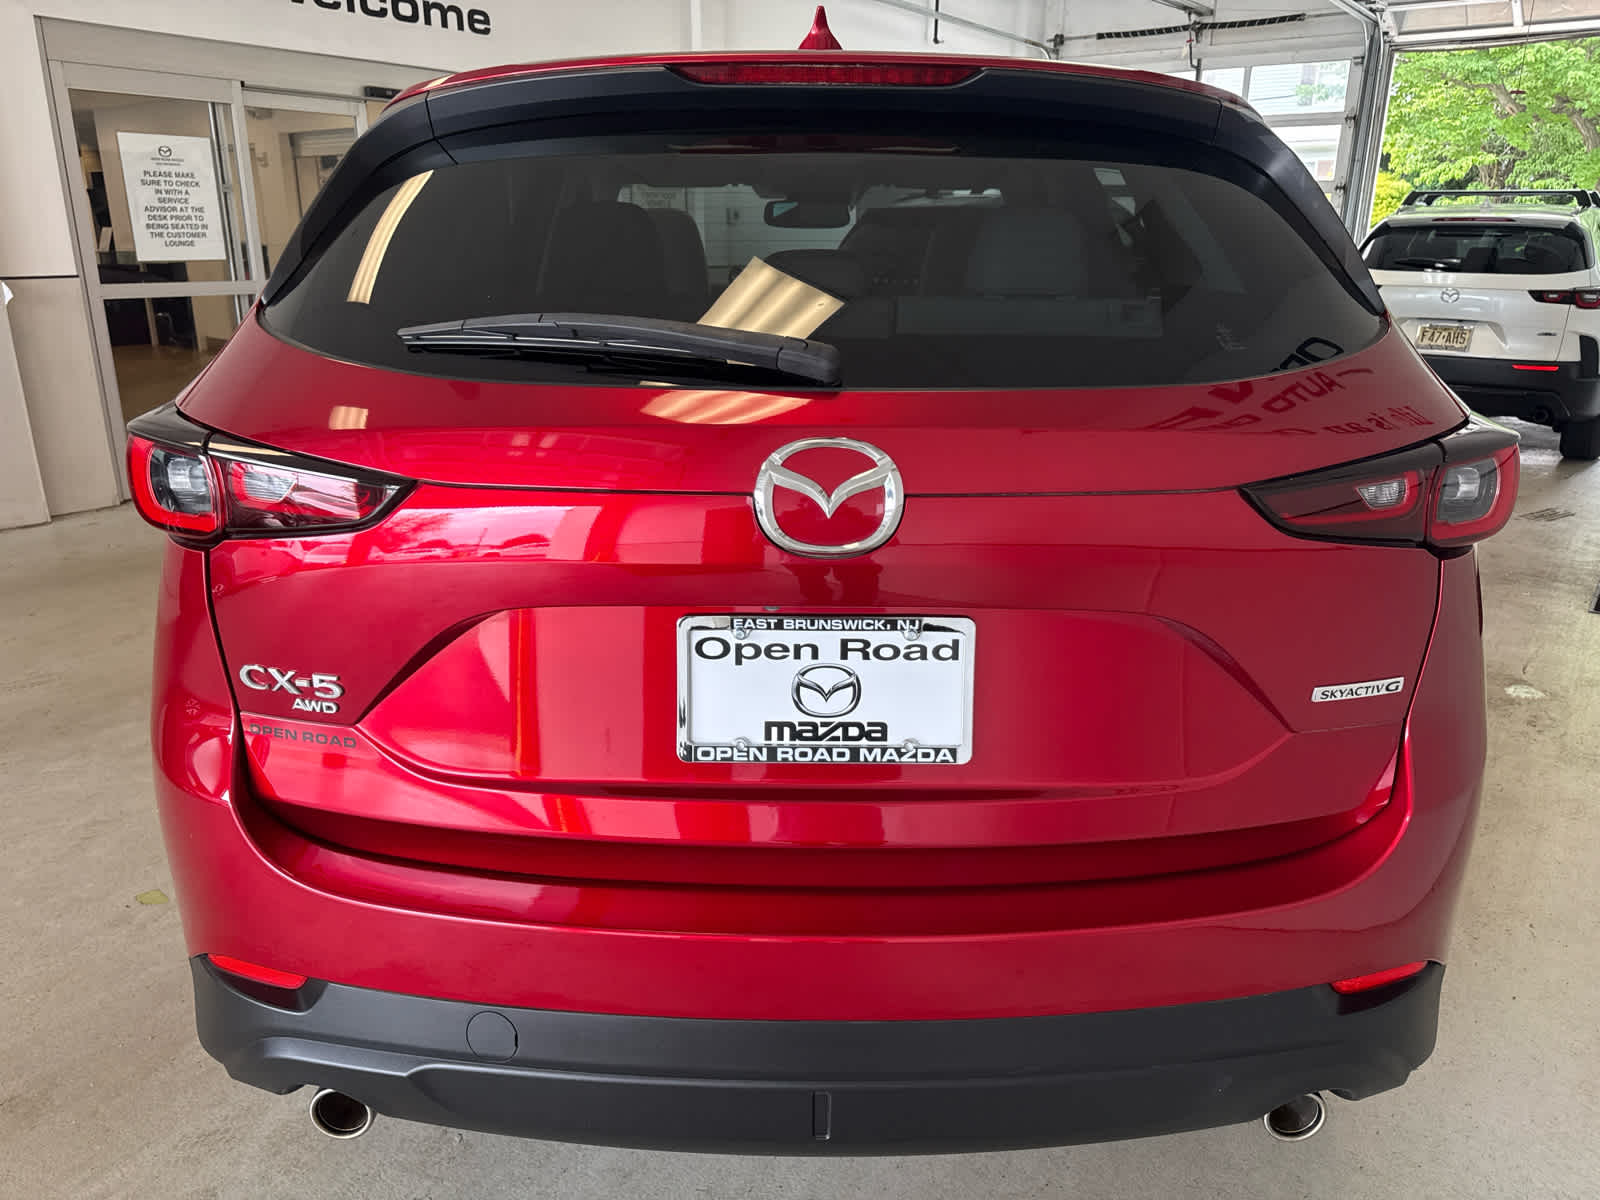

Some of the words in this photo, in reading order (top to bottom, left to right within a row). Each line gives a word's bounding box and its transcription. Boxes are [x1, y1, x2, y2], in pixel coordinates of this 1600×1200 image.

[292, 0, 491, 35] come
[143, 170, 173, 178] PLEASE
[141, 179, 162, 187] SURE
[175, 180, 200, 188] CHECK
[150, 231, 165, 239] THE
[166, 231, 207, 239] CUSTOMER
[733, 618, 778, 630] EAST
[783, 619, 892, 631] BRUNSWICK,
[897, 619, 920, 631] NJ
[694, 636, 820, 666] Open
[839, 638, 960, 662] Road
[239, 663, 345, 699] CX-5
[292, 698, 339, 714] AWD
[249, 723, 298, 741] OPEN
[301, 731, 357, 749] ROAD
[695, 746, 771, 762] OPEN
[776, 747, 850, 762] ROAD
[859, 748, 957, 763] MAZDA
